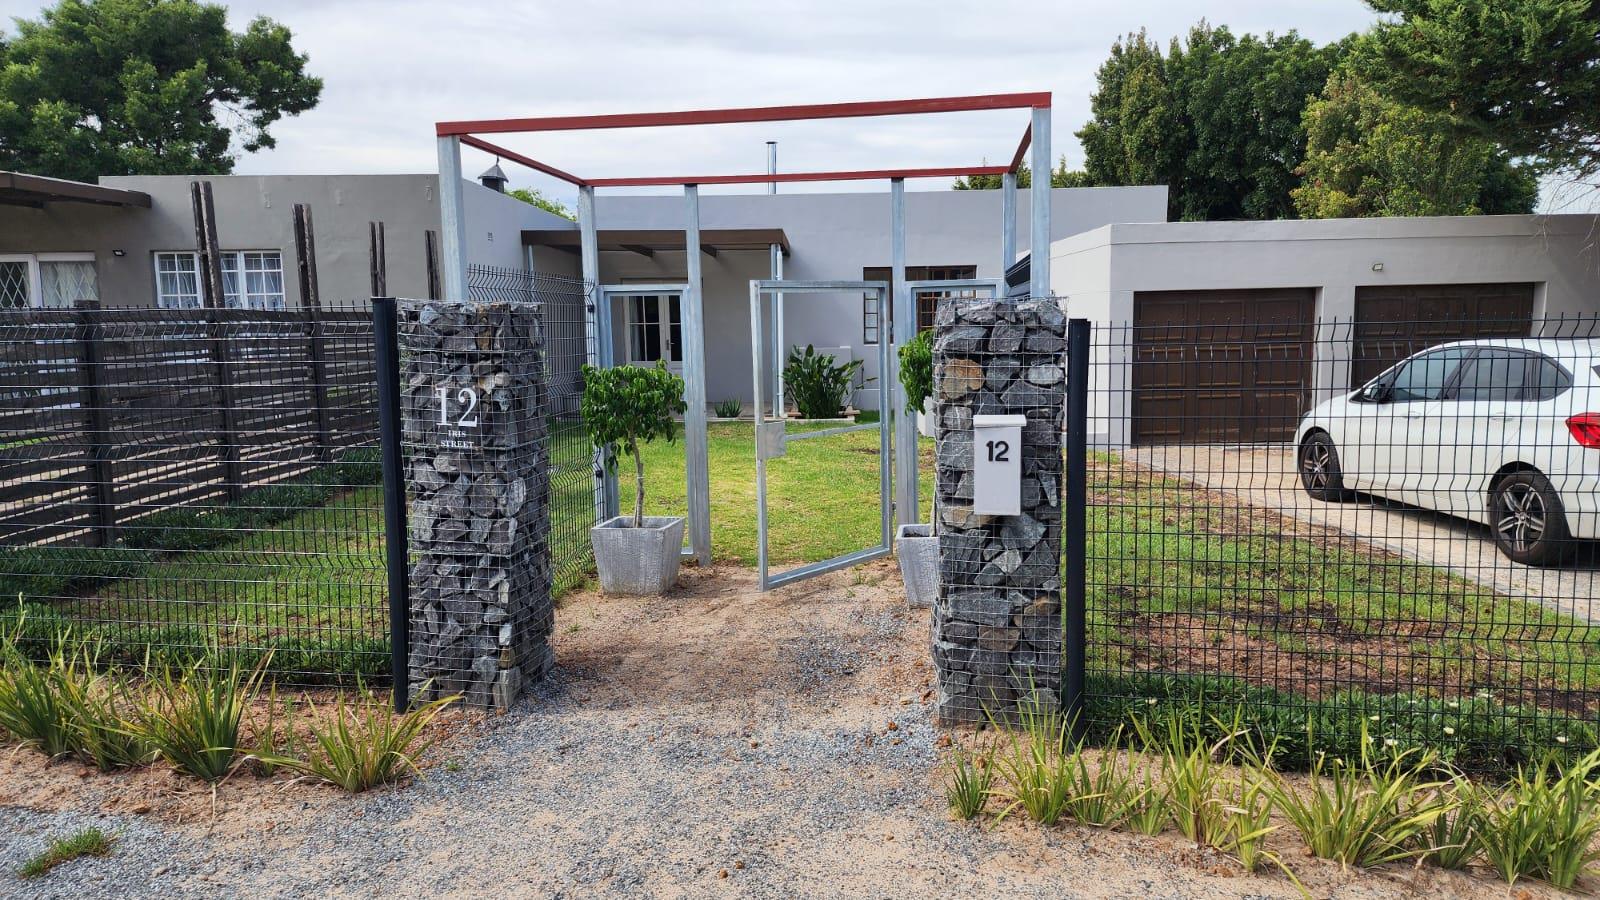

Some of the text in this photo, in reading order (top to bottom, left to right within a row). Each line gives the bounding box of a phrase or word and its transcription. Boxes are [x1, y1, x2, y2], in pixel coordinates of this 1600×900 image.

[435, 387, 477, 427] 12
[448, 430, 466, 438] IRIS
[441, 440, 474, 449] STREET
[986, 440, 1009, 462] 12
